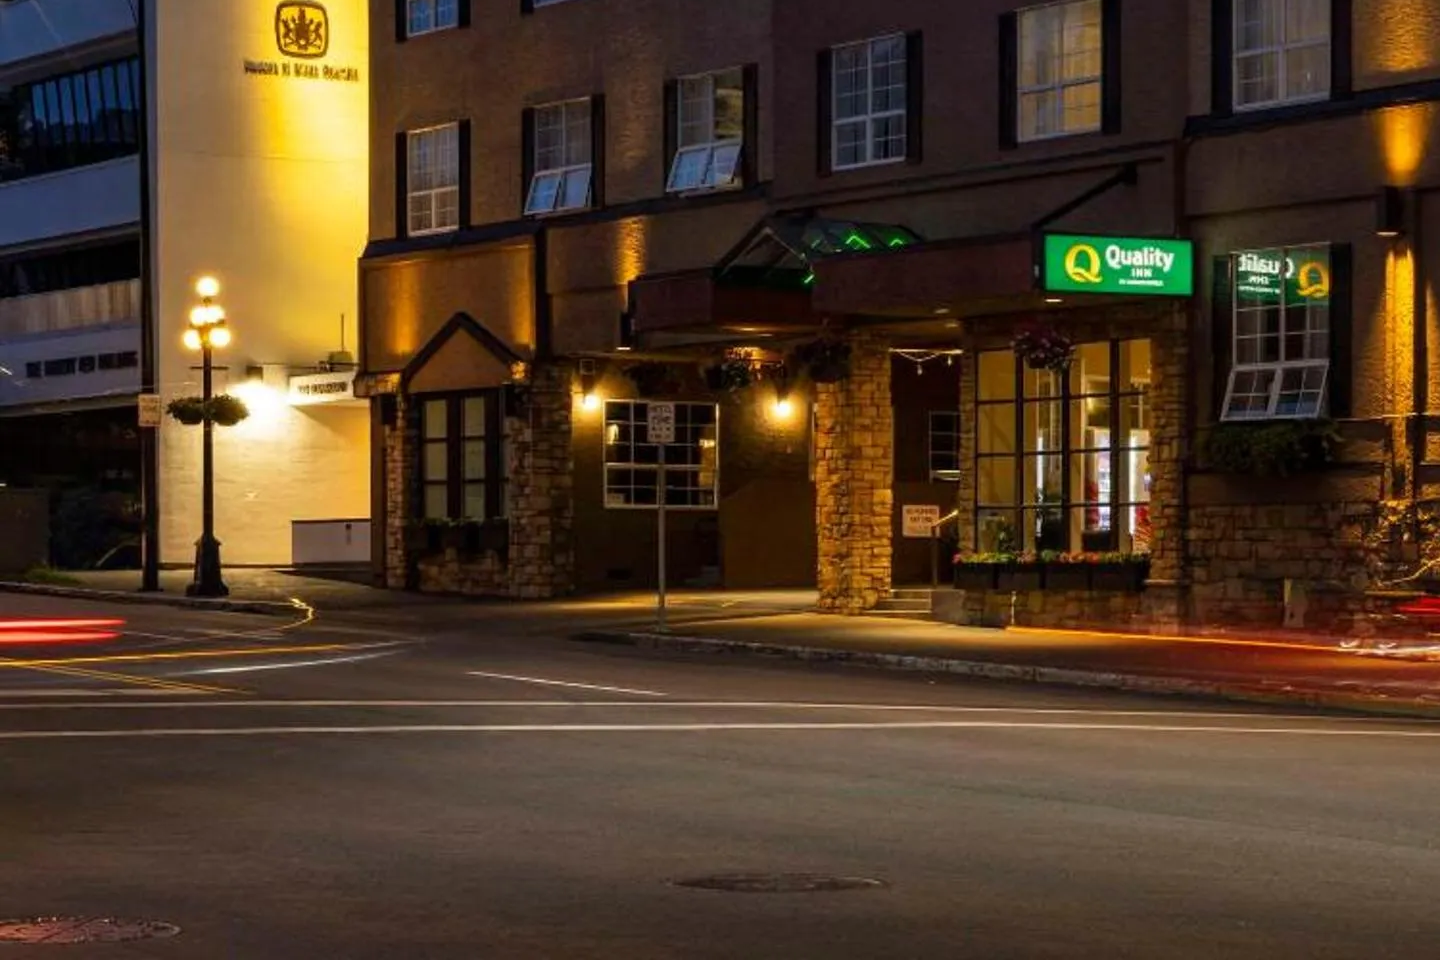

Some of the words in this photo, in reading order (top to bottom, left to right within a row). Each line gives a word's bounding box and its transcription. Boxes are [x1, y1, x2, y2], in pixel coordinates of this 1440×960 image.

[1064, 243, 1102, 283] Q
[1105, 244, 1175, 273] Quality
[1131, 268, 1153, 278] INN
